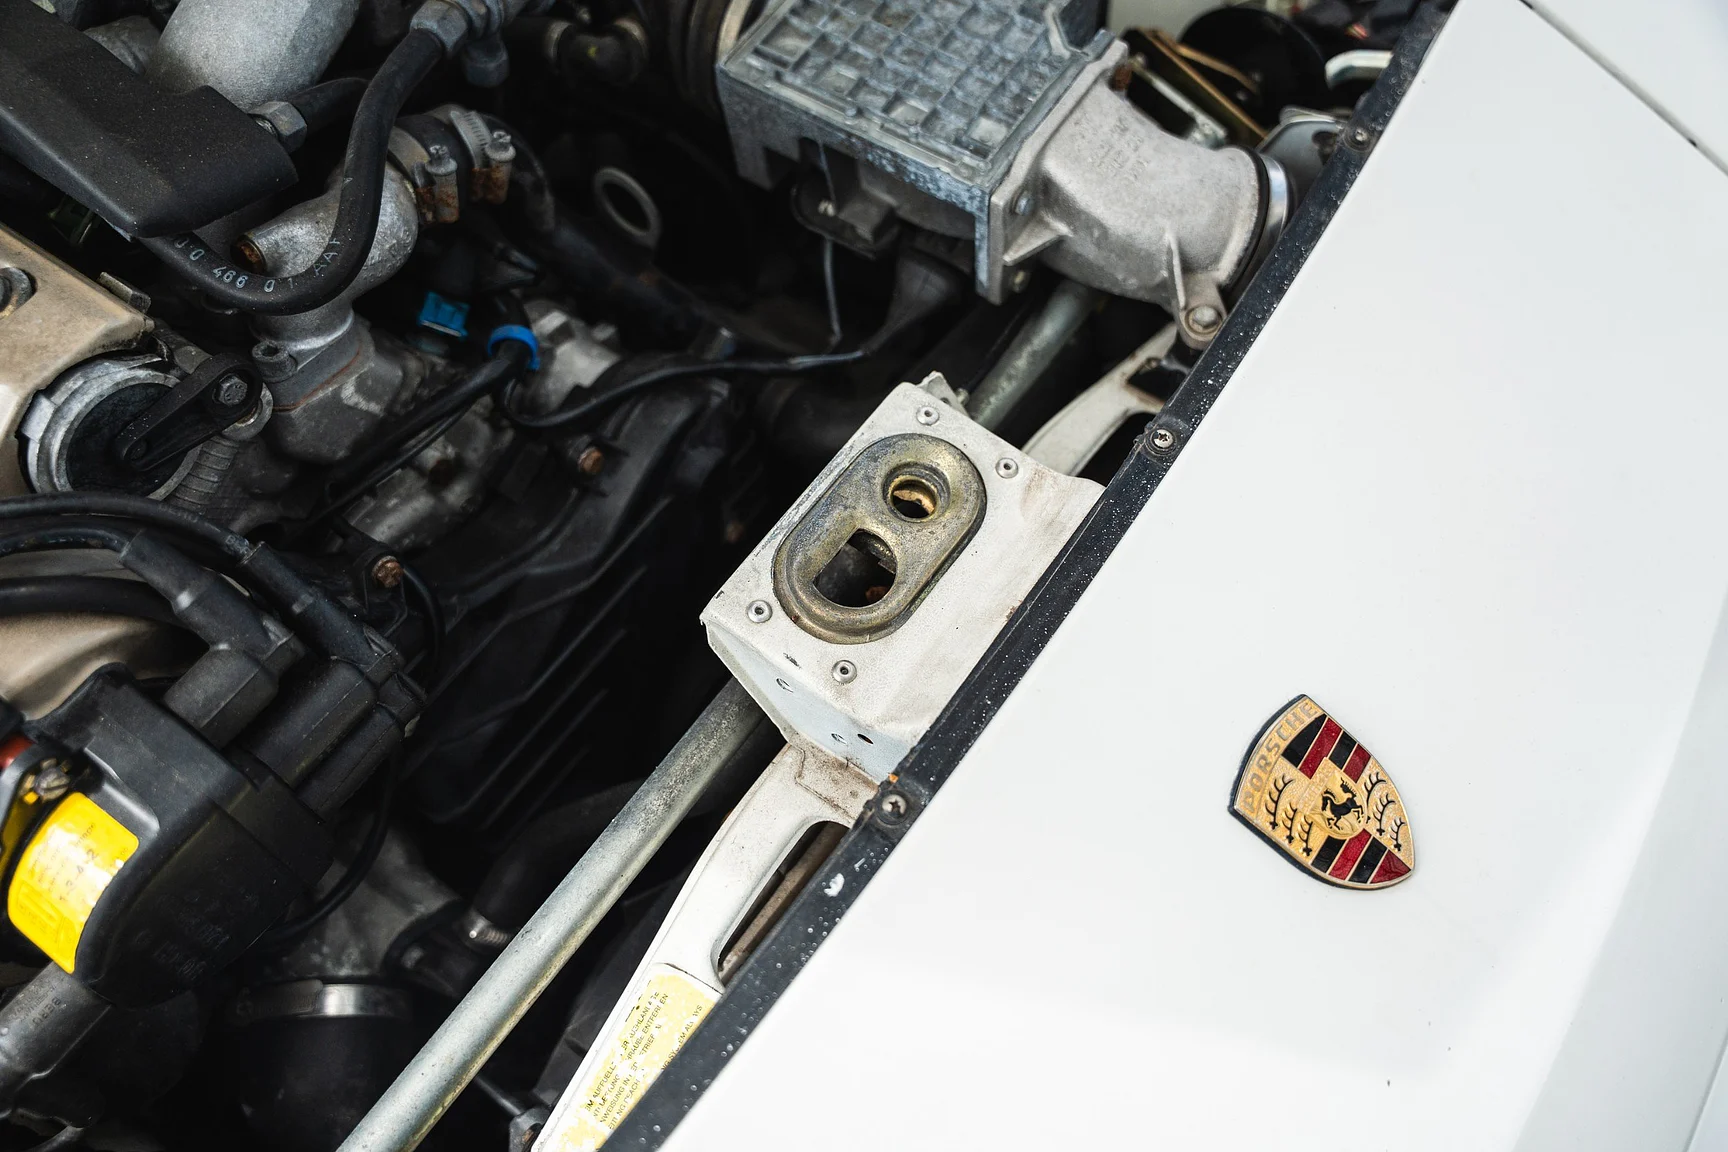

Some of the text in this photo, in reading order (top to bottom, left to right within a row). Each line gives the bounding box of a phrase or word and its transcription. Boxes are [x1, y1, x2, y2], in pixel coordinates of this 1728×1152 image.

[212, 266, 248, 289] 466
[1242, 702, 1319, 815] PORSCHE
[32, 996, 61, 1025] BERU
